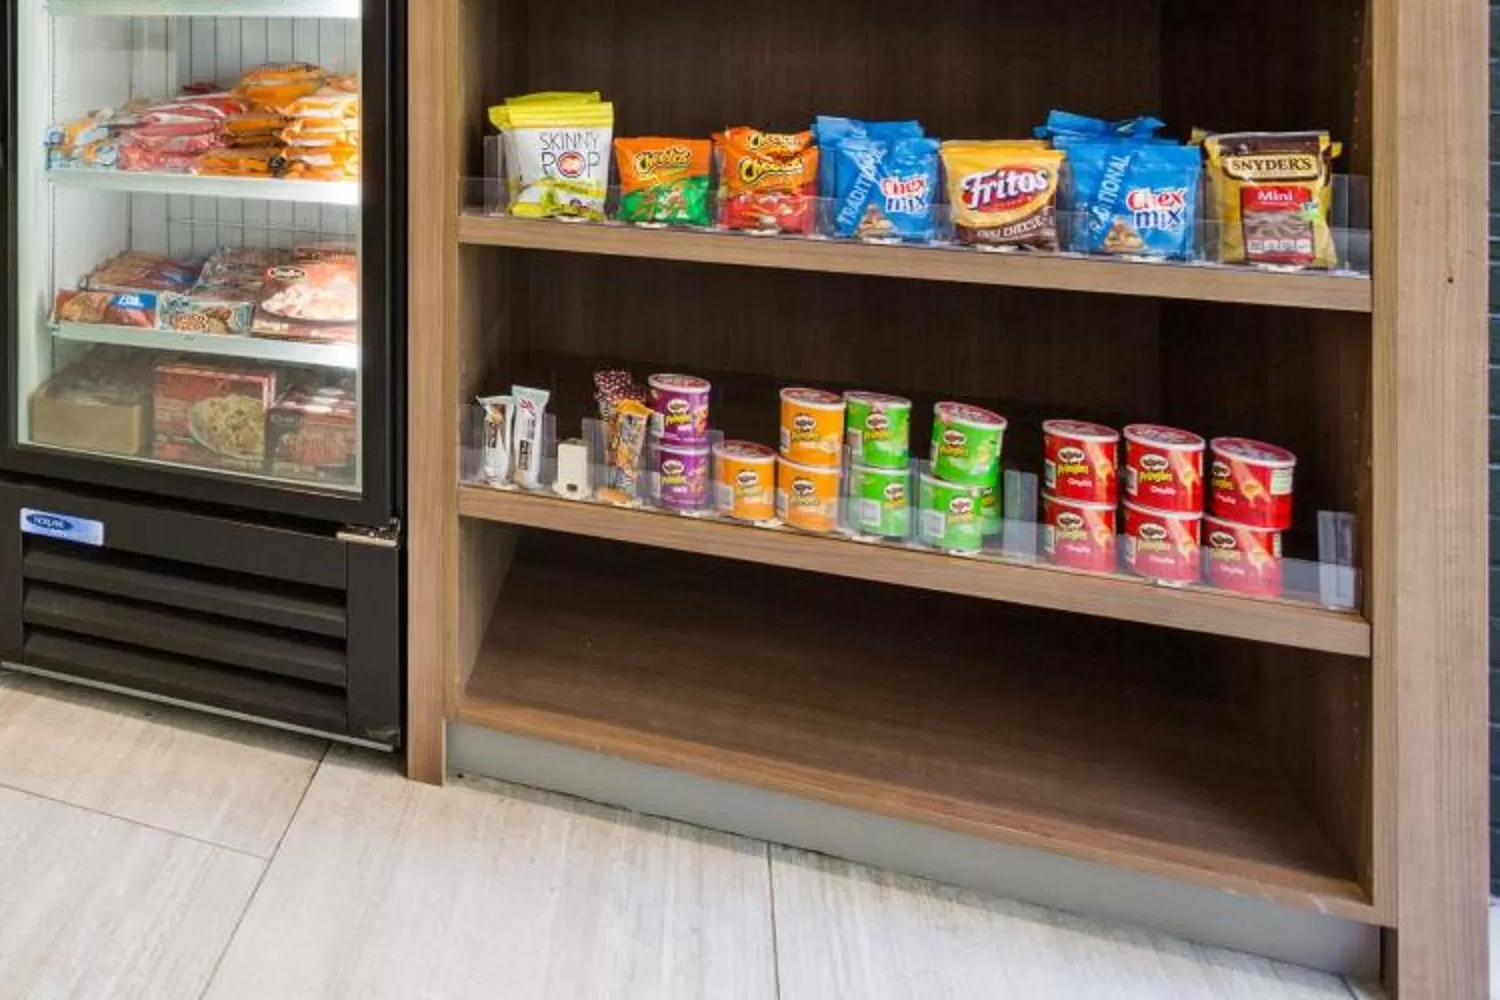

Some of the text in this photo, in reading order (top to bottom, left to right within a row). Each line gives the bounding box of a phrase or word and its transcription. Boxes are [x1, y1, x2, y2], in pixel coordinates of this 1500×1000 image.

[540, 131, 599, 150] SKINNY
[542, 151, 601, 178] POP
[880, 174, 928, 197] Chex
[961, 168, 1049, 209] Fritos
[1257, 191, 1293, 201] Mini
[1127, 188, 1188, 210] Chex
[1134, 209, 1184, 230] mix
